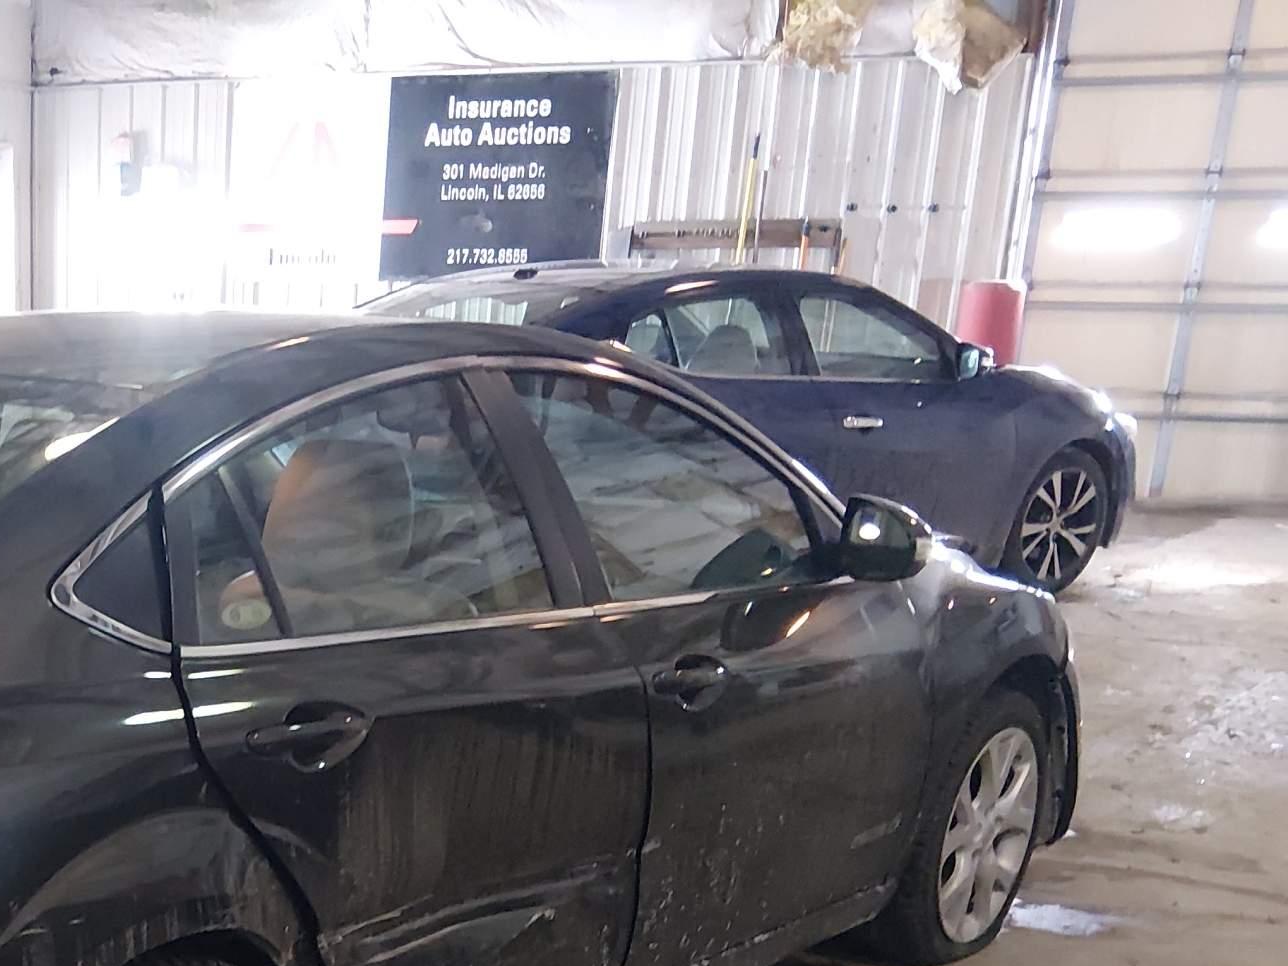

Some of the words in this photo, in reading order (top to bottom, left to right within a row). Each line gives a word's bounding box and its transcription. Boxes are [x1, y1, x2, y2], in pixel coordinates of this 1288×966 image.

[448, 95, 552, 120] Insurance
[424, 123, 473, 147] Auto
[477, 121, 572, 147] Auctions
[442, 163, 464, 180] 301
[528, 162, 546, 179] Dr.
[440, 184, 489, 202] Lincoln,
[493, 184, 505, 200] IL
